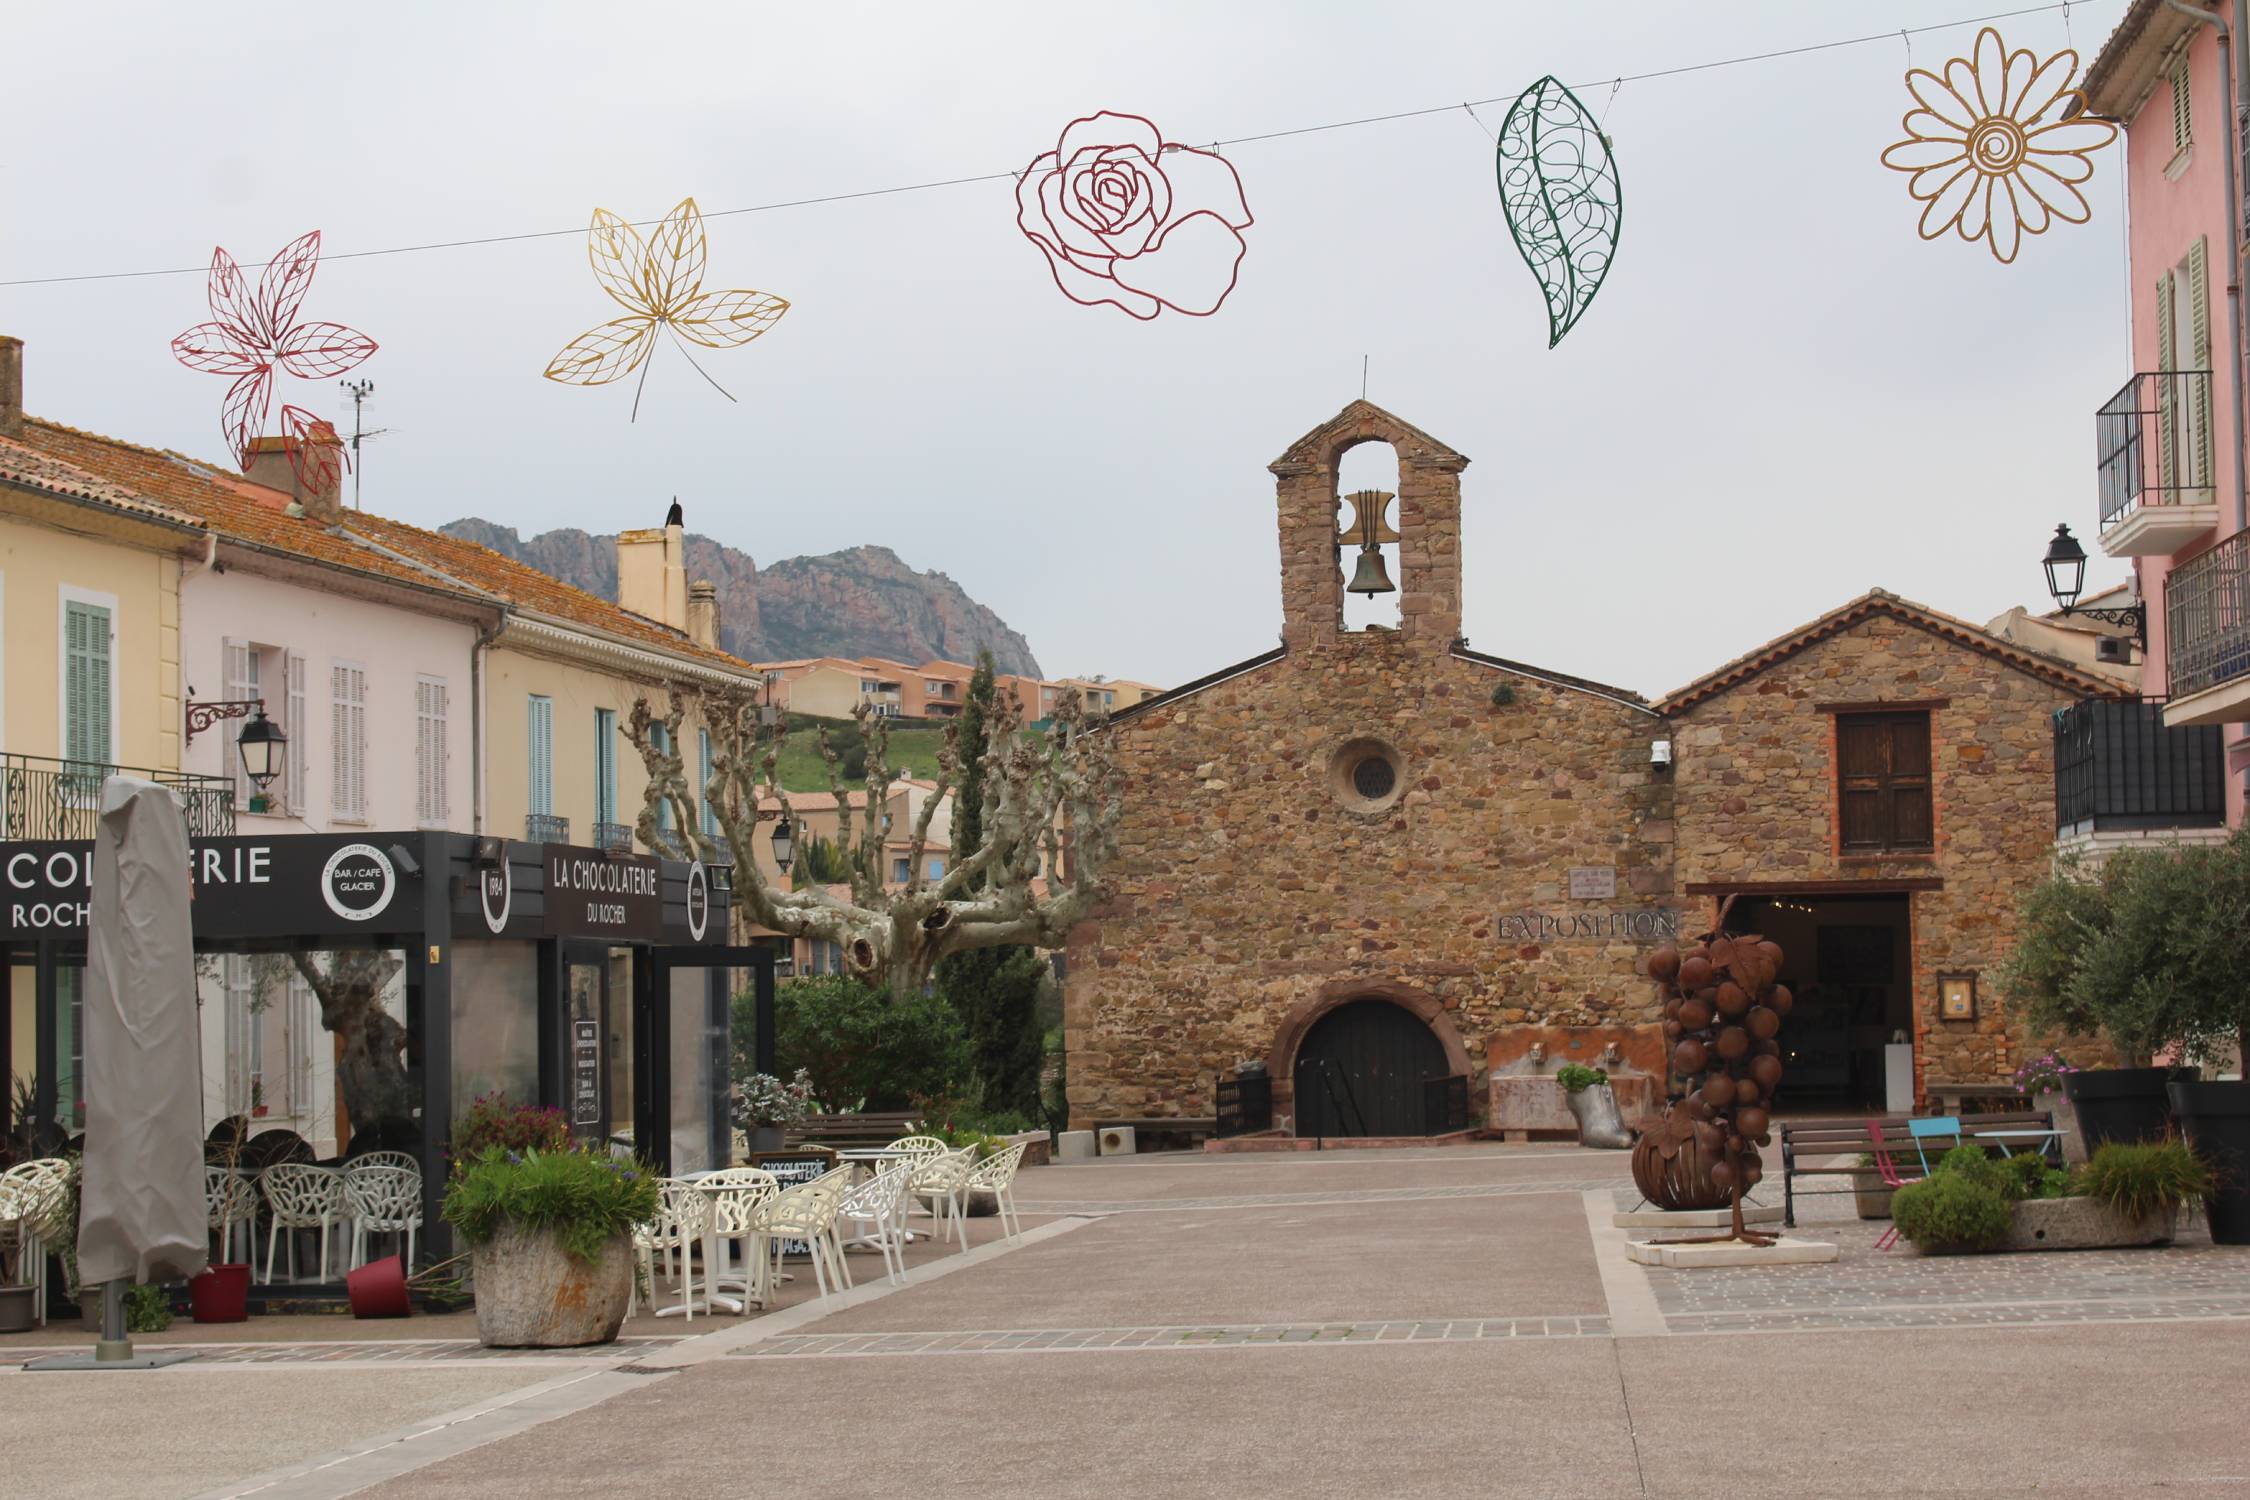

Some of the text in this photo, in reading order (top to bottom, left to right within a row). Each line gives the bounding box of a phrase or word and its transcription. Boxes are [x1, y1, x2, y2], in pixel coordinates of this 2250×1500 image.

[334, 869, 352, 878] BAR
[553, 857, 569, 888] LA
[573, 859, 657, 896] CHOCOLATERIE
[340, 882, 376, 892] GLACIER
[587, 902, 626, 924] DU ROCHER
[1498, 911, 1678, 940] EXPOSITION
